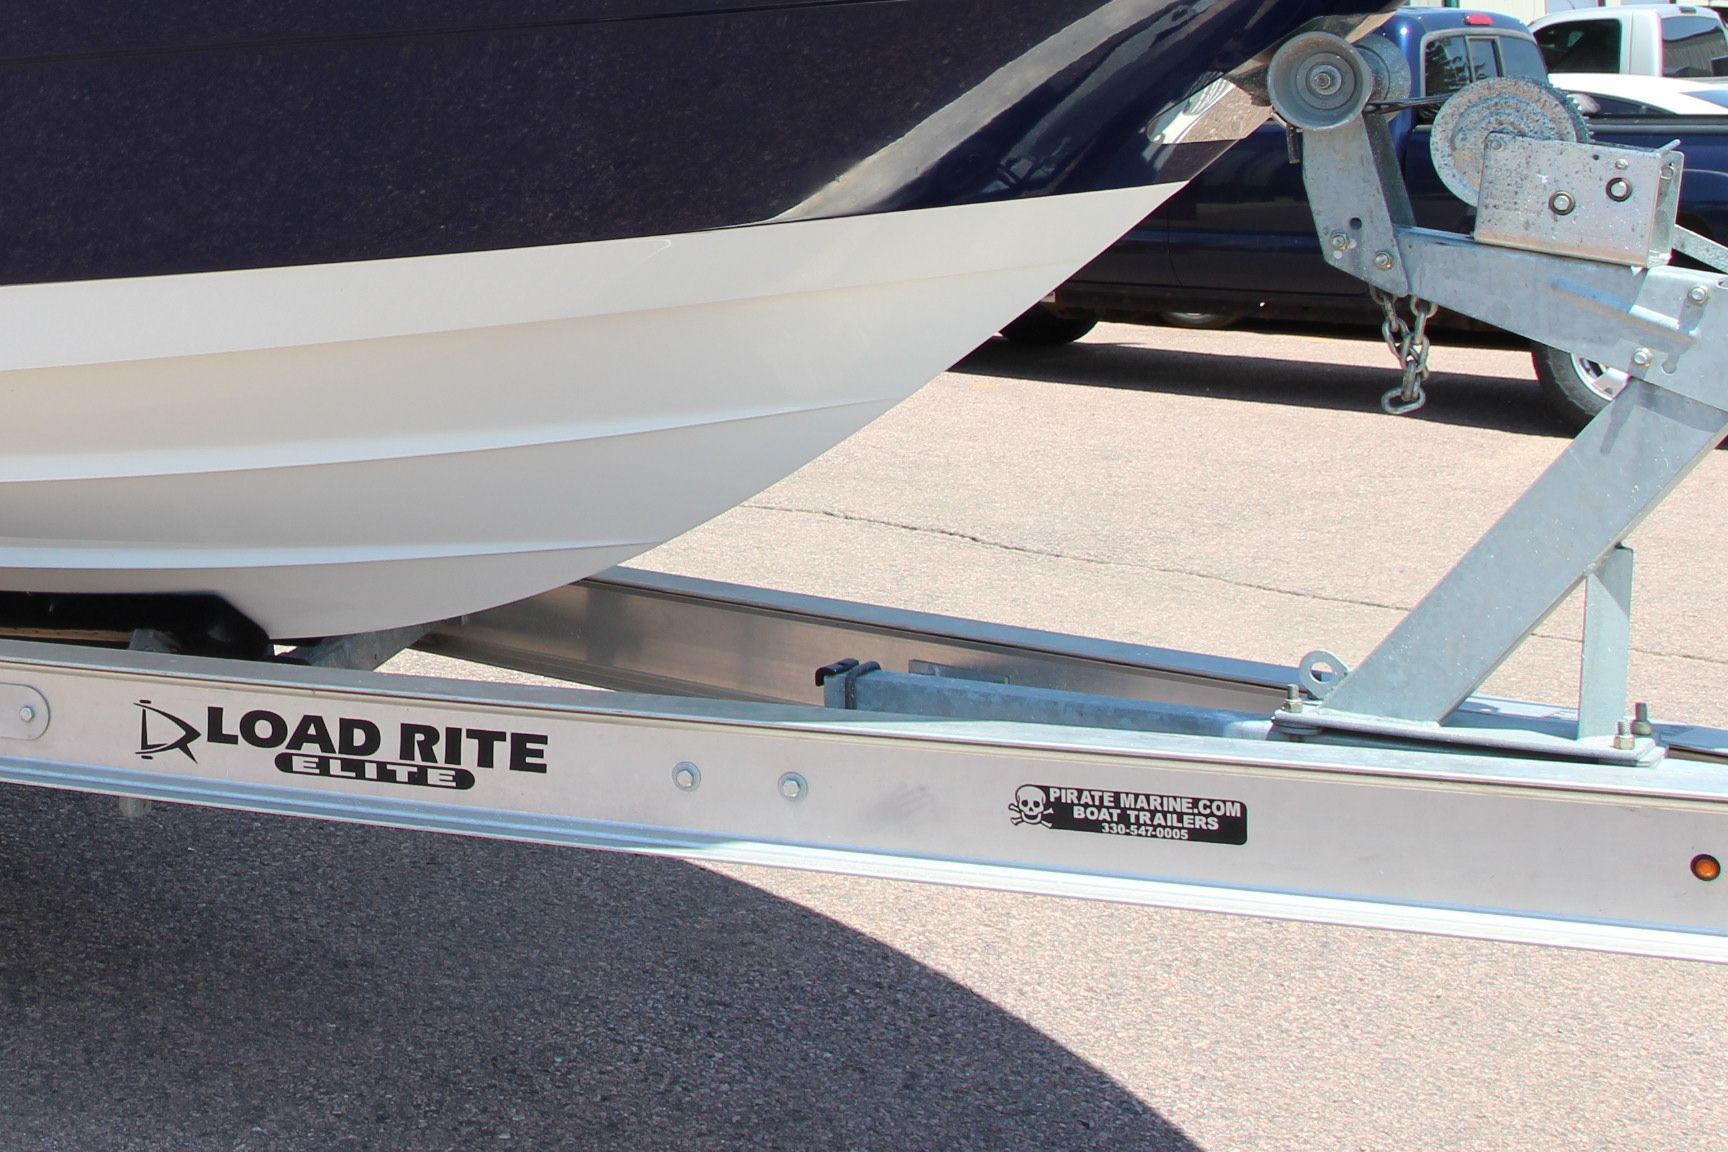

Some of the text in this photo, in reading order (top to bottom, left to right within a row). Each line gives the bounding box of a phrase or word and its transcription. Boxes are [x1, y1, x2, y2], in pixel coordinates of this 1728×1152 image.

[206, 706, 549, 774] LOAD RITE
[291, 756, 457, 787] ELITE
[1049, 787, 1242, 818] PIRATE MARINE.COM
[1073, 806, 1219, 831] BOAT TRAILERS
[1101, 822, 1189, 841] 330-547-0005
